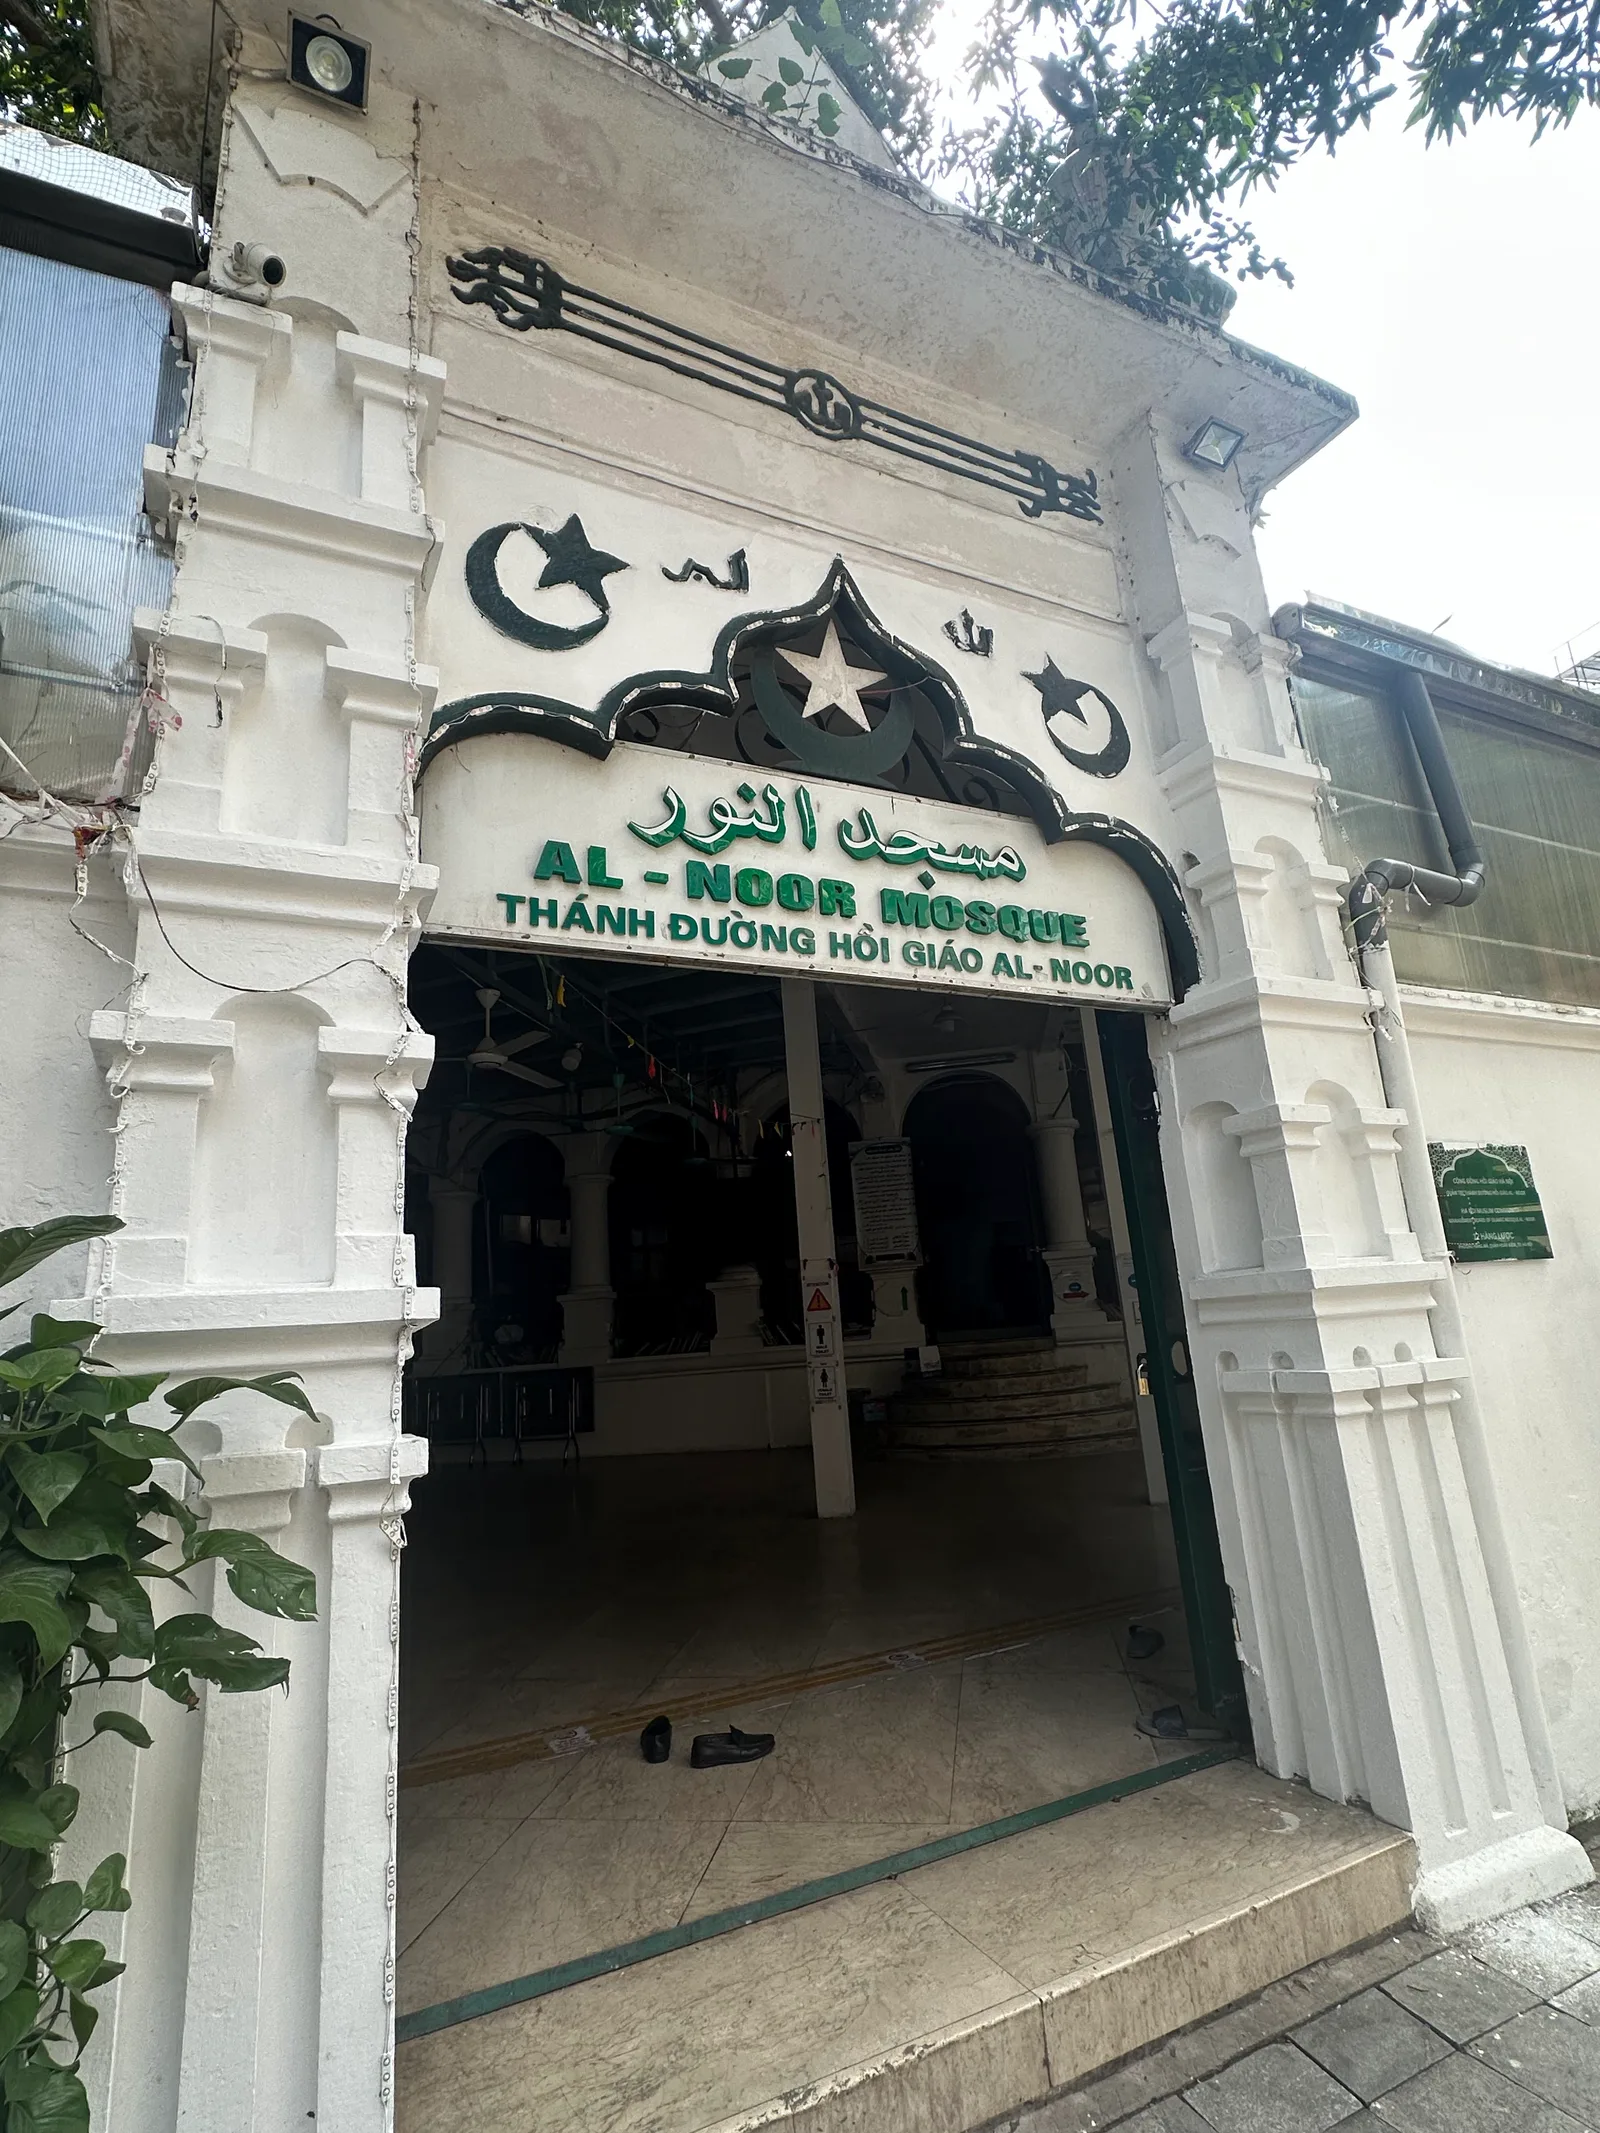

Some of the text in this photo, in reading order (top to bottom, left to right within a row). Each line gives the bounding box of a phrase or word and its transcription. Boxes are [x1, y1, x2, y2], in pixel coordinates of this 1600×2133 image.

[627, 782, 1027, 890] مسجد النور
[496, 893, 655, 938] THÁNH
[668, 910, 816, 954] ĐƯỜNG
[829, 922, 890, 963] HỒI
[902, 939, 983, 973] GIÁO
[686, 860, 857, 918] NOOR
[880, 887, 1090, 948] MOSQUE
